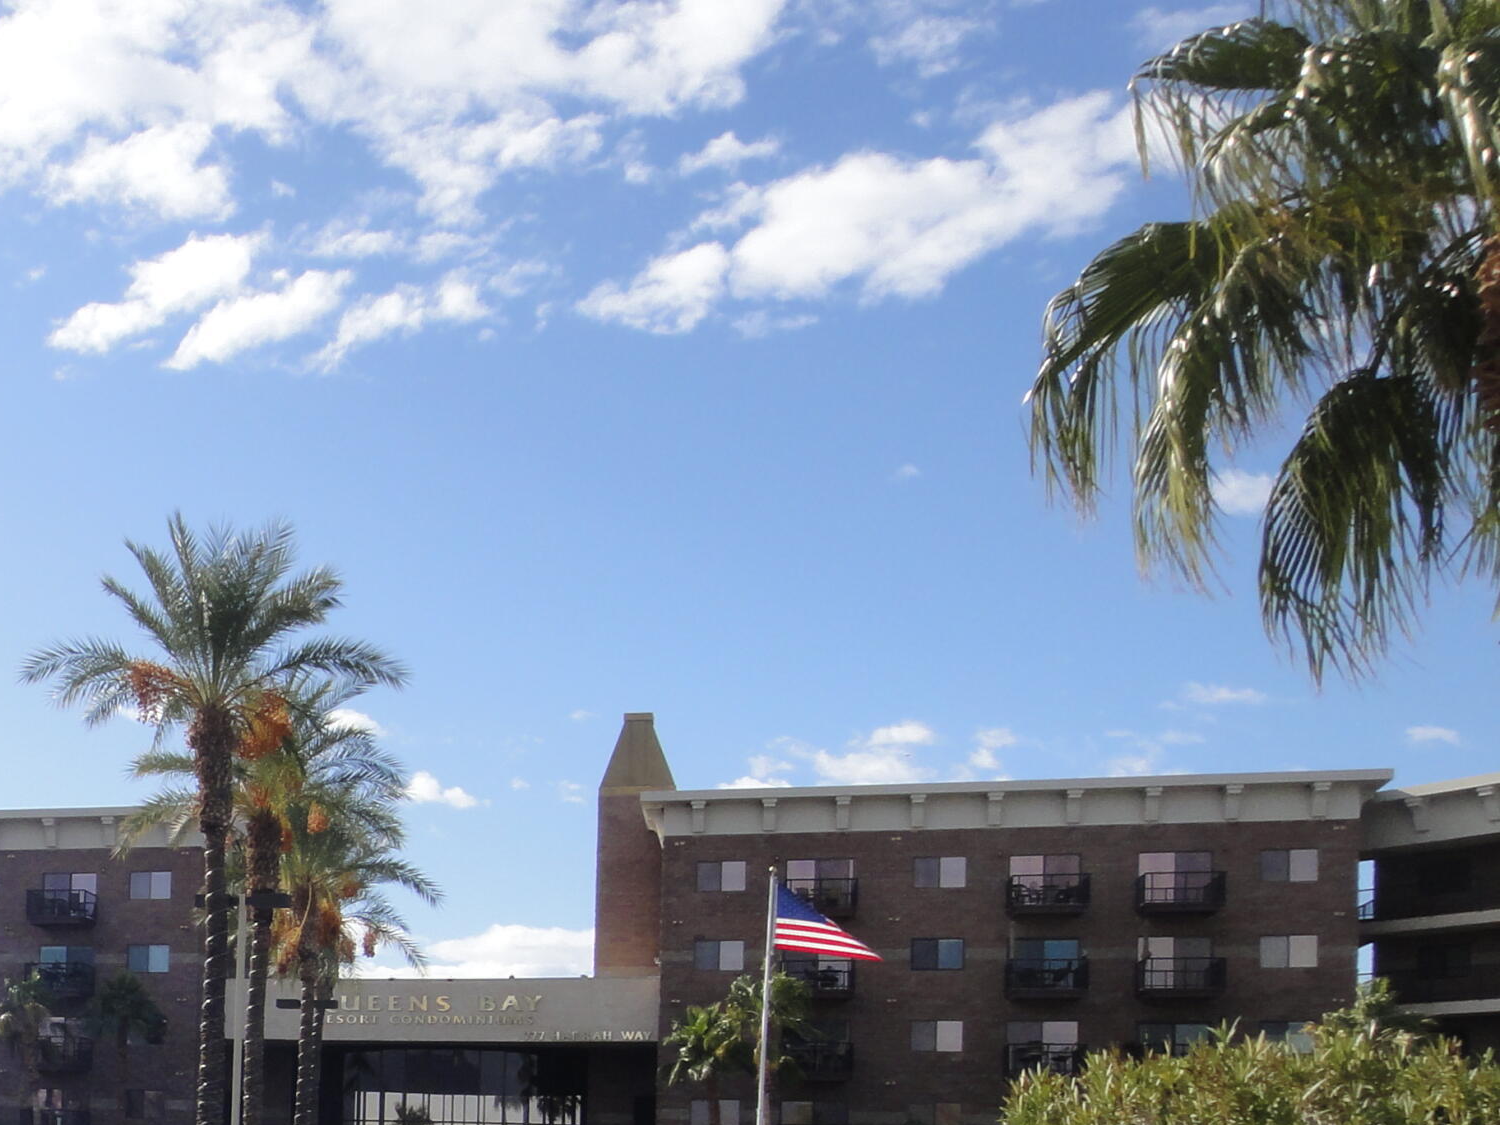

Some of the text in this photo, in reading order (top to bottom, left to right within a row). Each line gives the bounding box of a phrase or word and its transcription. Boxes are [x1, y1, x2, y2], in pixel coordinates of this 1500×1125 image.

[325, 995, 542, 1013] UEENS BAY
[326, 1014, 379, 1024] ESORT
[621, 1031, 652, 1040] WAY
